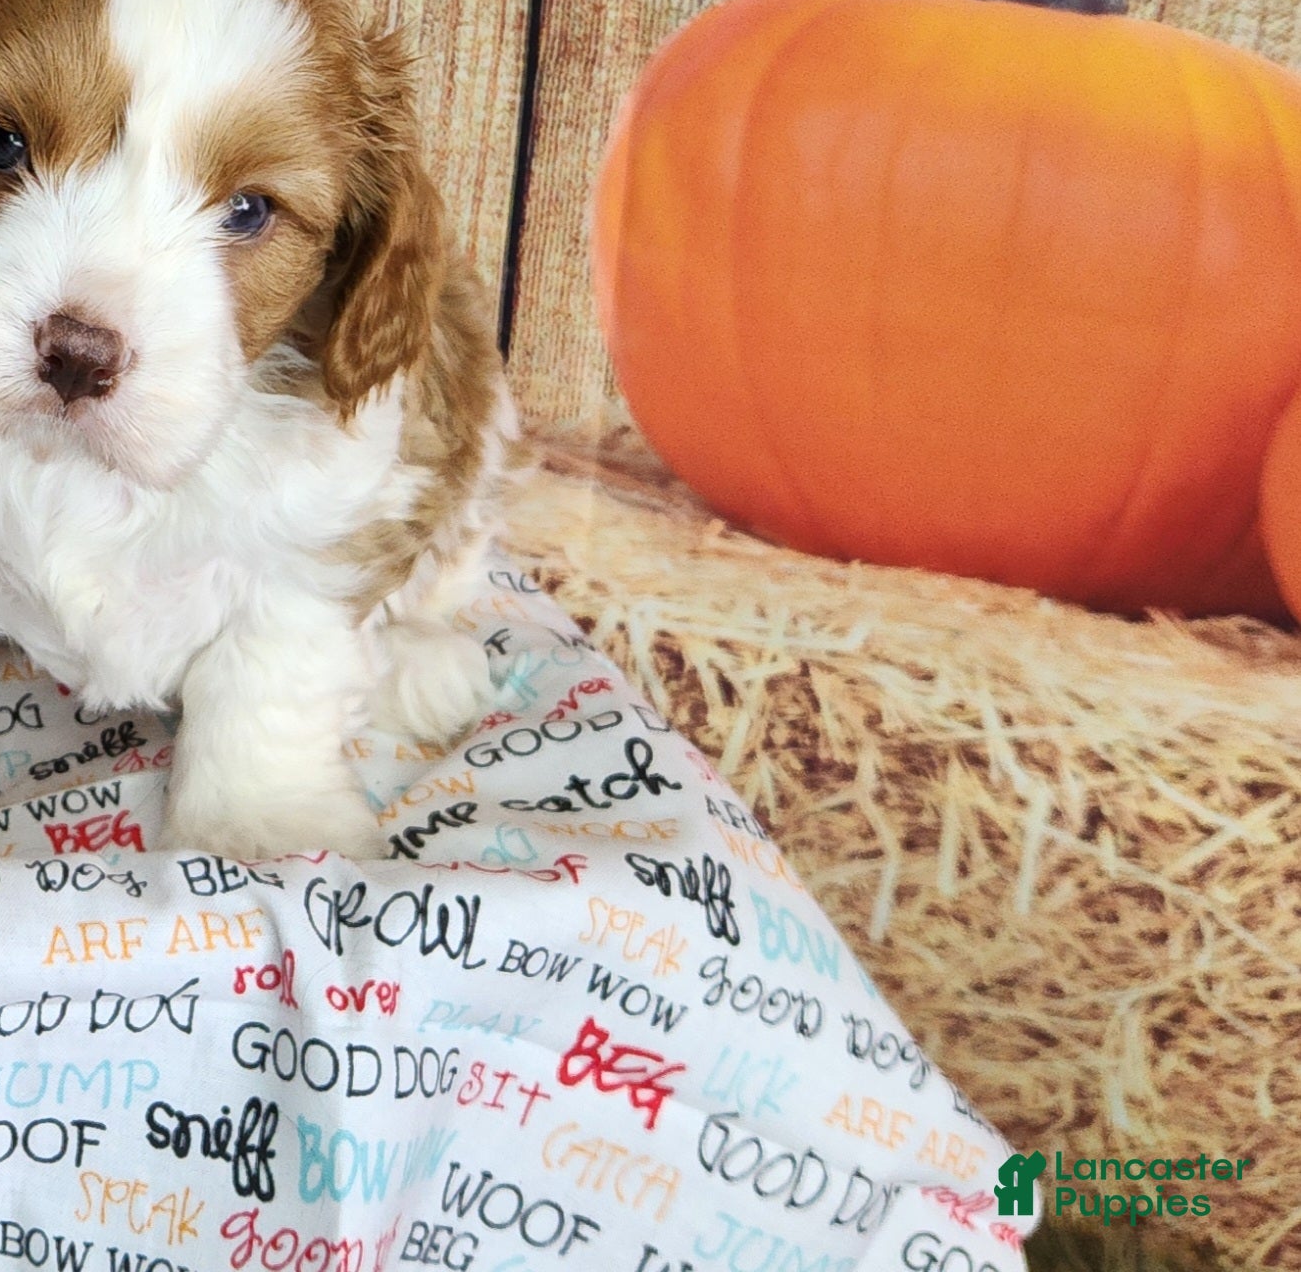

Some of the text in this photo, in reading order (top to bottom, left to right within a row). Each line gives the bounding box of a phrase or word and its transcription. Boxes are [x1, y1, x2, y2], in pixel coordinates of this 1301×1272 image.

[29, 721, 148, 780] sniff
[464, 710, 623, 768] GOOD
[501, 737, 683, 813] catch
[23, 781, 123, 819] WOW
[44, 809, 148, 854] BEG
[42, 908, 266, 966] ARF ARF
[303, 877, 487, 970] GROWL
[579, 896, 689, 978] SPEAK
[625, 853, 741, 947] sniff
[748, 886, 842, 982] BOW
[89, 978, 201, 1035] DOG
[325, 979, 401, 1017] over
[416, 998, 545, 1044] PLAY
[498, 938, 689, 1034] BOW WOW
[232, 1021, 460, 1100] GOOD DOG
[556, 1015, 687, 1132] BEG
[146, 1096, 280, 1203] sniff
[542, 1122, 684, 1224] CATCH
[698, 1111, 830, 1210] GOOD
[823, 1092, 916, 1152] ARF
[916, 1128, 989, 1183] ARF
[75, 1170, 205, 1246] SPEAK
[400, 1219, 480, 1272] BEG
[441, 1161, 601, 1257] WOOF
